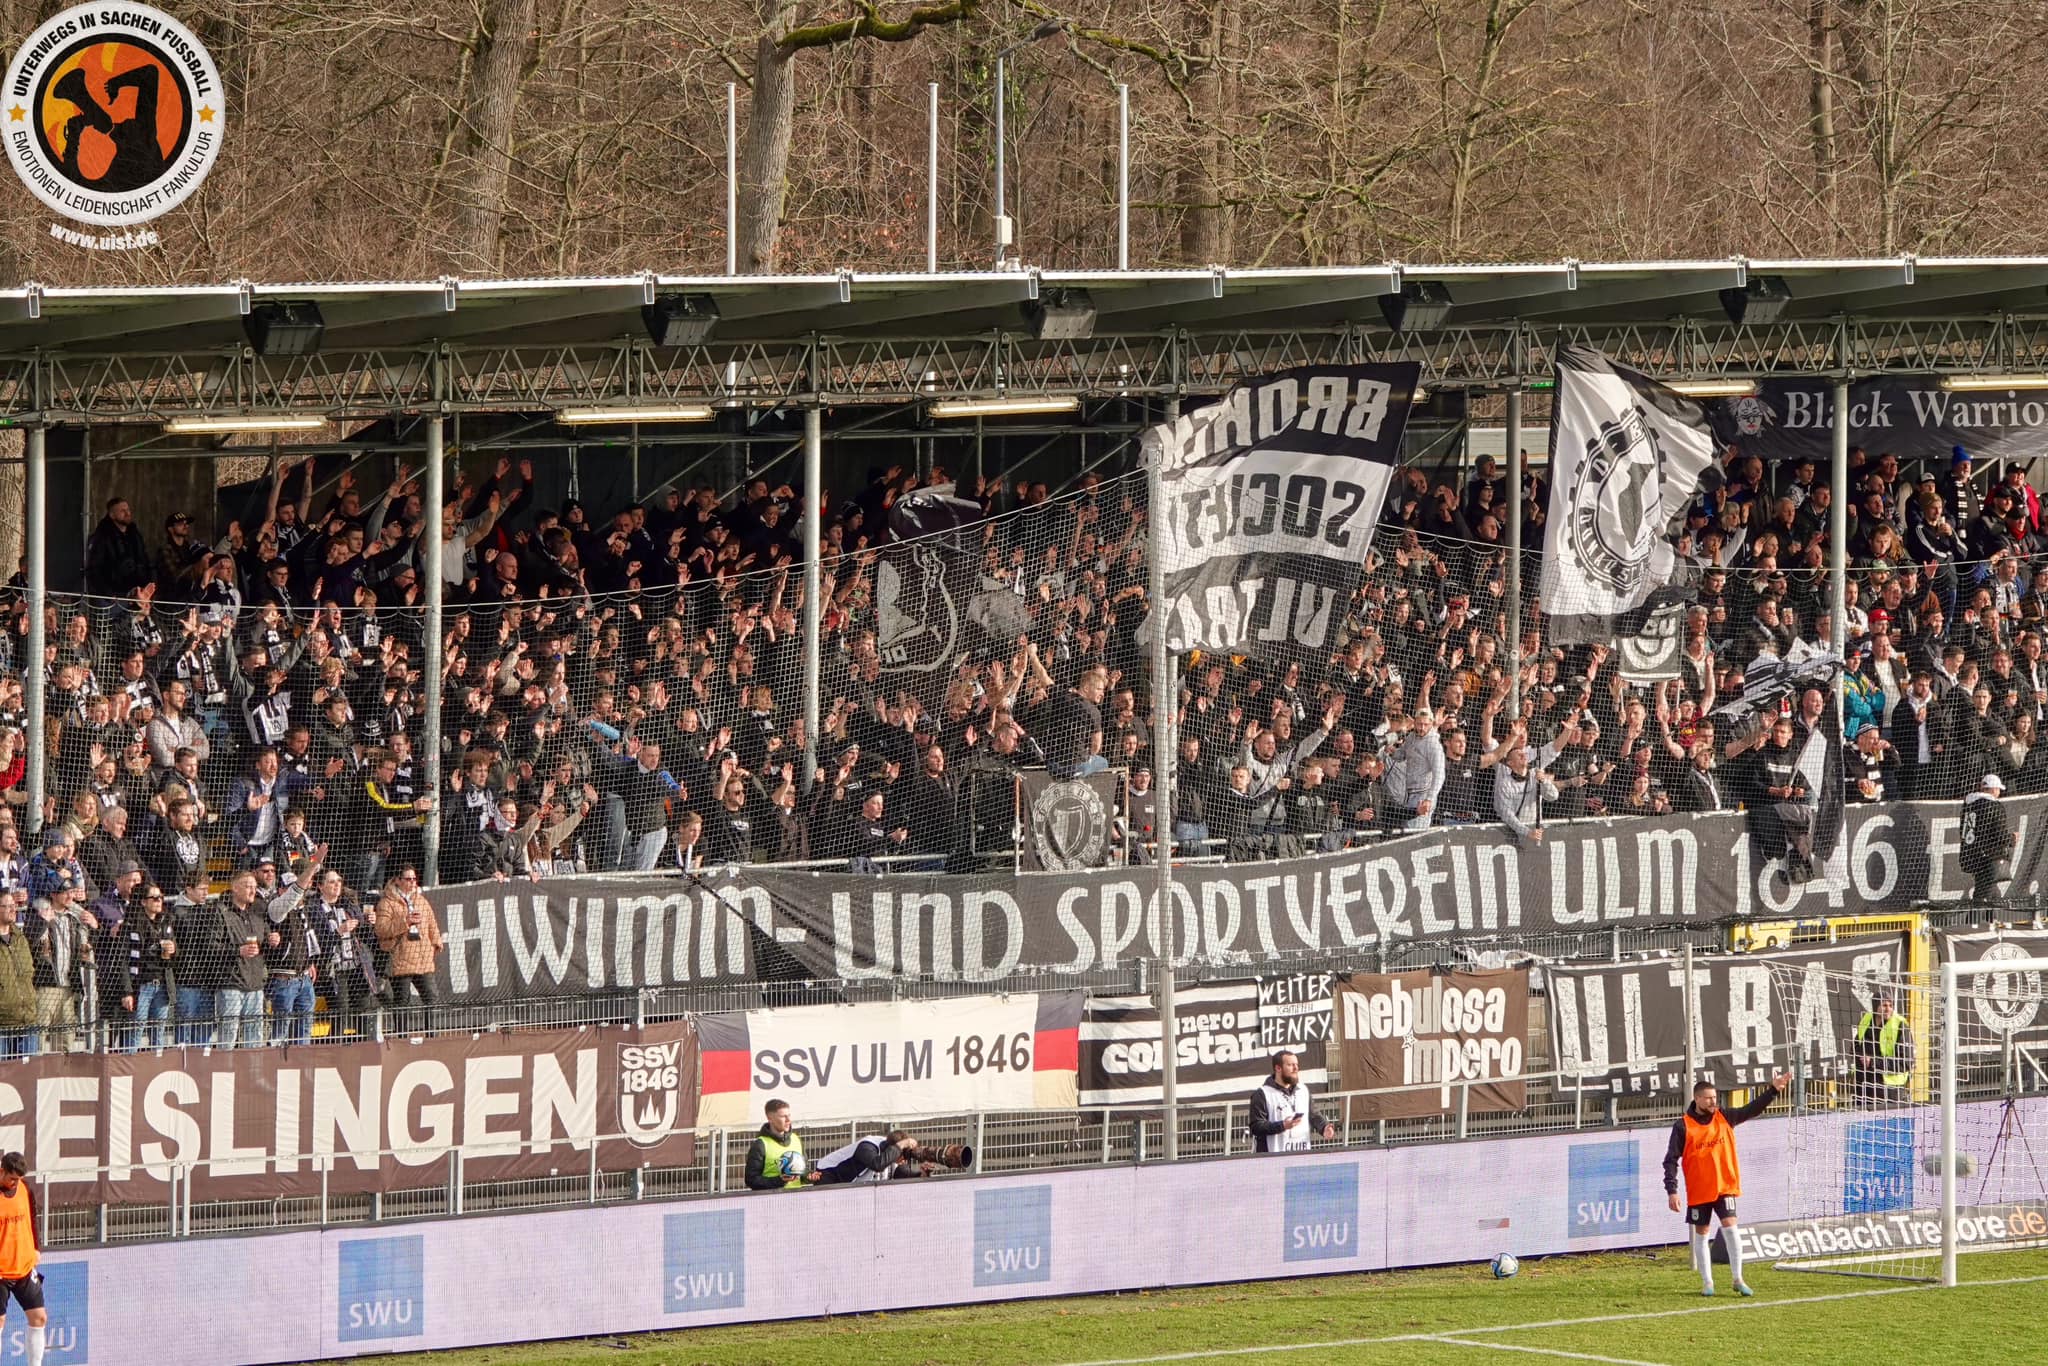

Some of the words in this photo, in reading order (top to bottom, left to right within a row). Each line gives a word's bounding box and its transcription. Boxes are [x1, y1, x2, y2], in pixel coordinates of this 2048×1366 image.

[1784, 390, 1893, 429] Blck
[1907, 390, 2048, 429] Warrio
[1259, 974, 1332, 1004] WEITER
[1342, 976, 1506, 1039] nebulosa
[1261, 1012, 1332, 1044] HENRY
[622, 1042, 680, 1069] SSV
[753, 1045, 837, 1090] SSV
[851, 1039, 933, 1084] ULM
[946, 1032, 1031, 1076] 1846
[622, 1066, 678, 1093] 1846
[1402, 1036, 1522, 1108] impero
[1577, 1199, 1630, 1225] SWU
[1293, 1222, 1348, 1249] SWU
[1739, 1218, 1892, 1260] Eisenbach
[1888, 1206, 2047, 1246] Treore.de
[984, 1246, 1041, 1273] SWU
[674, 1271, 735, 1300] SWU
[349, 1298, 413, 1328] SWU
